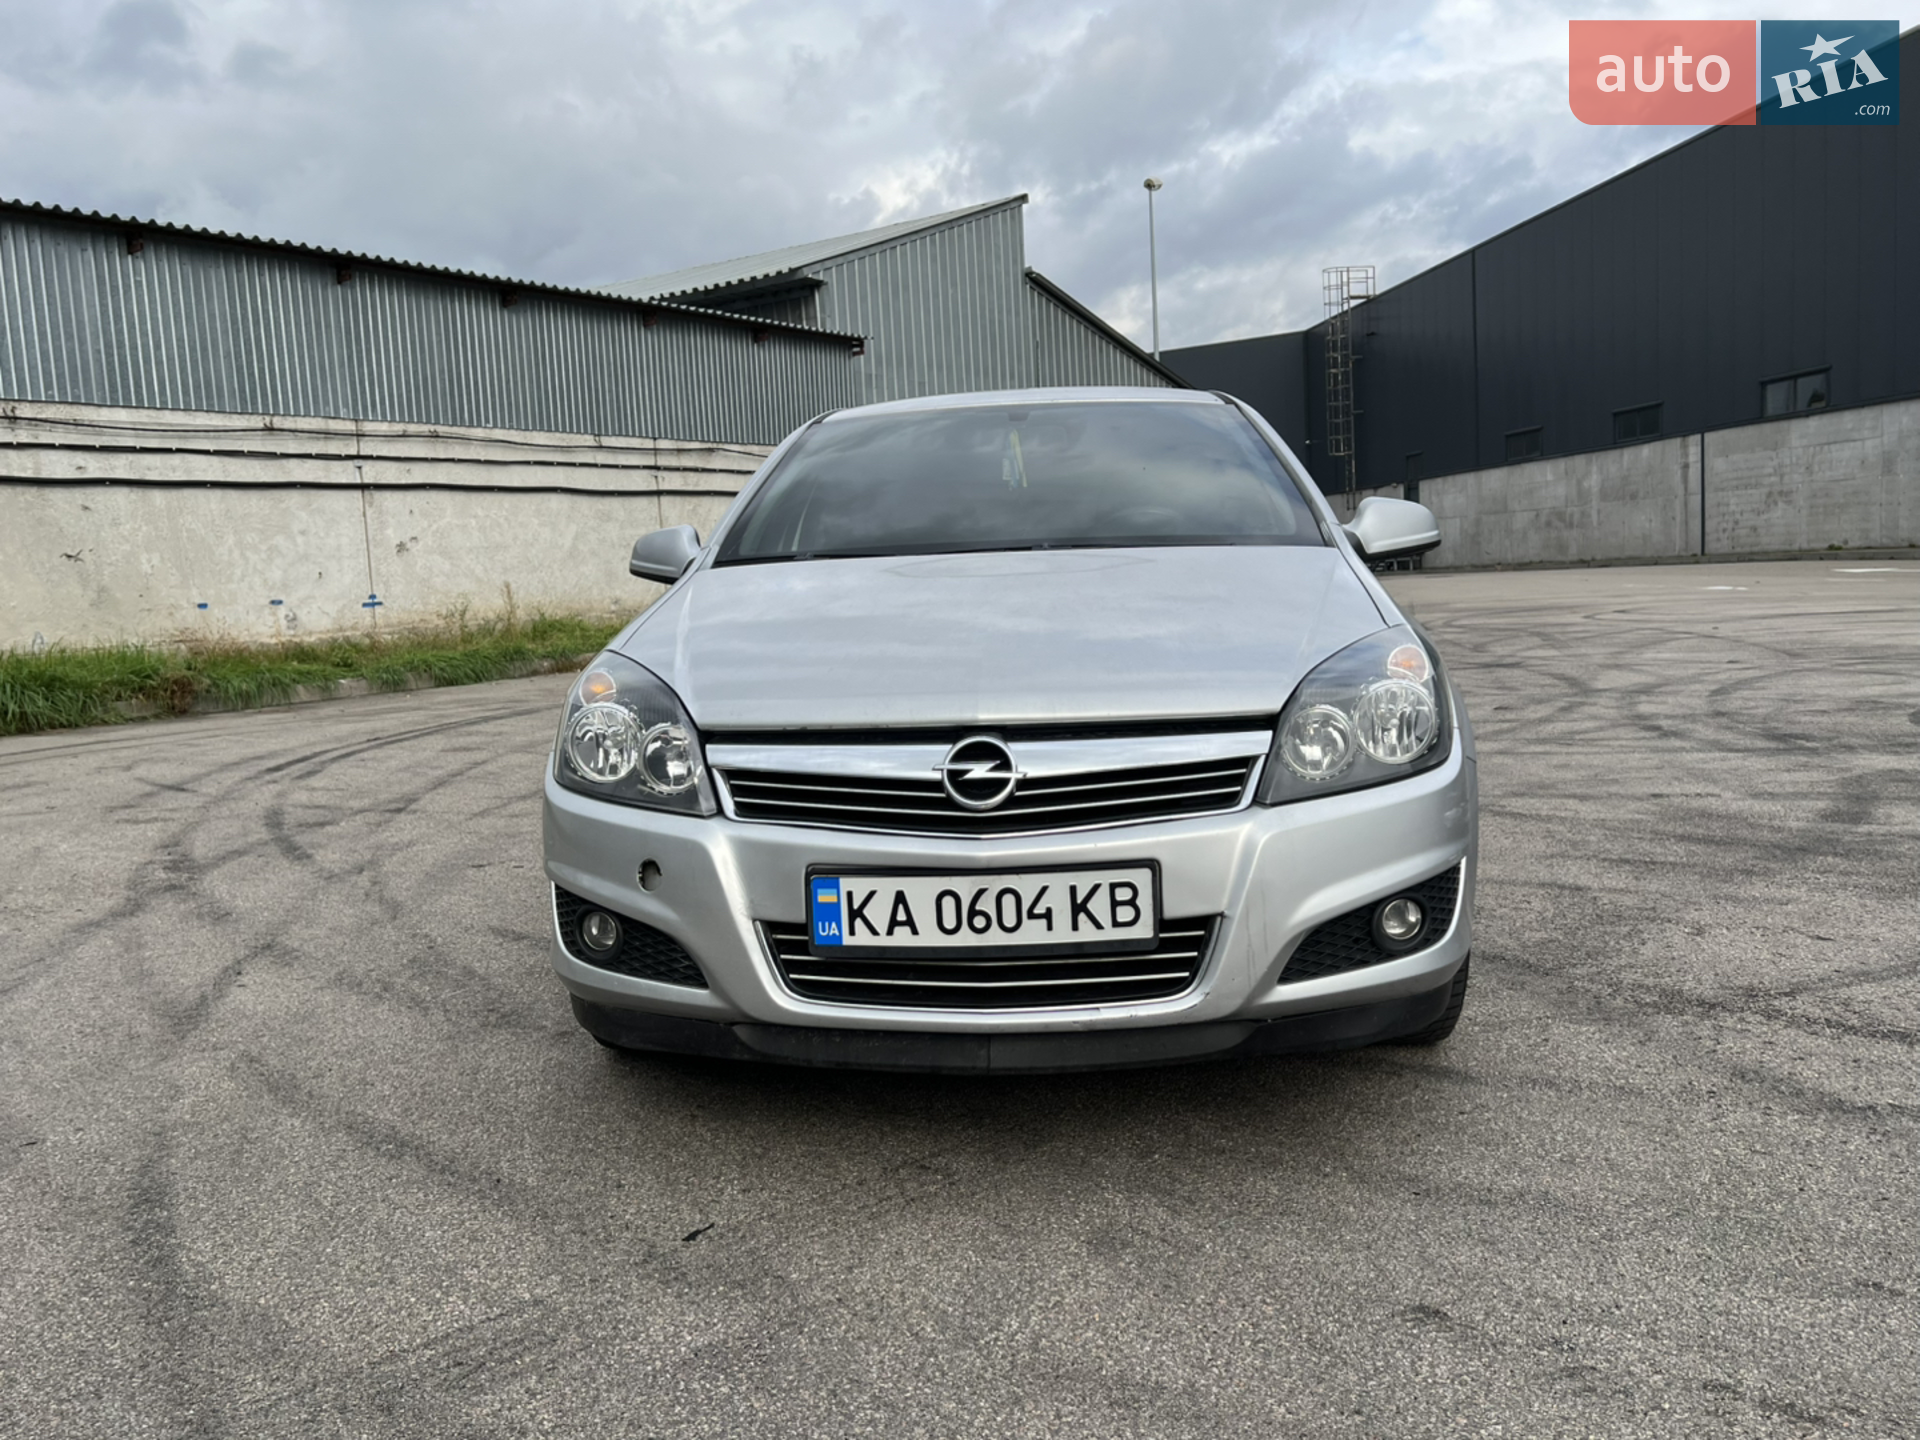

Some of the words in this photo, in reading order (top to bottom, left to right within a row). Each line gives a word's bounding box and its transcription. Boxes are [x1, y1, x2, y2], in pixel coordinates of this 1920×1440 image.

[846, 890, 919, 936] KA
[935, 885, 1053, 935] 0604
[1069, 881, 1141, 931] KB
[818, 922, 839, 936] UA
